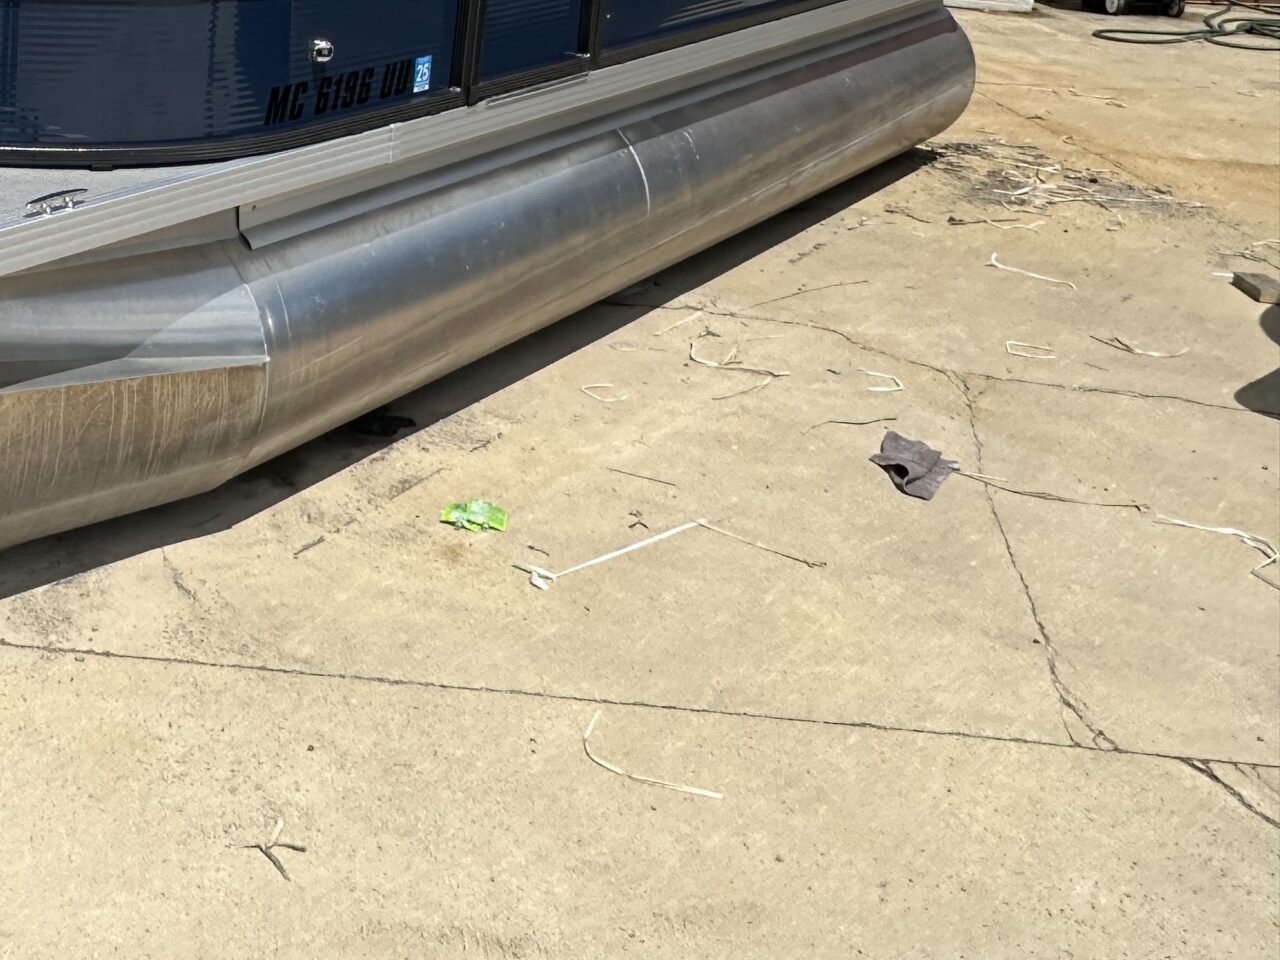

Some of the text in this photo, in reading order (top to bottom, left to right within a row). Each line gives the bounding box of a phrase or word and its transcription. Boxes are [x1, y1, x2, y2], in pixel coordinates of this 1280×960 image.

[415, 62, 430, 82] 25
[263, 81, 308, 126] MC
[314, 67, 376, 116] 6196
